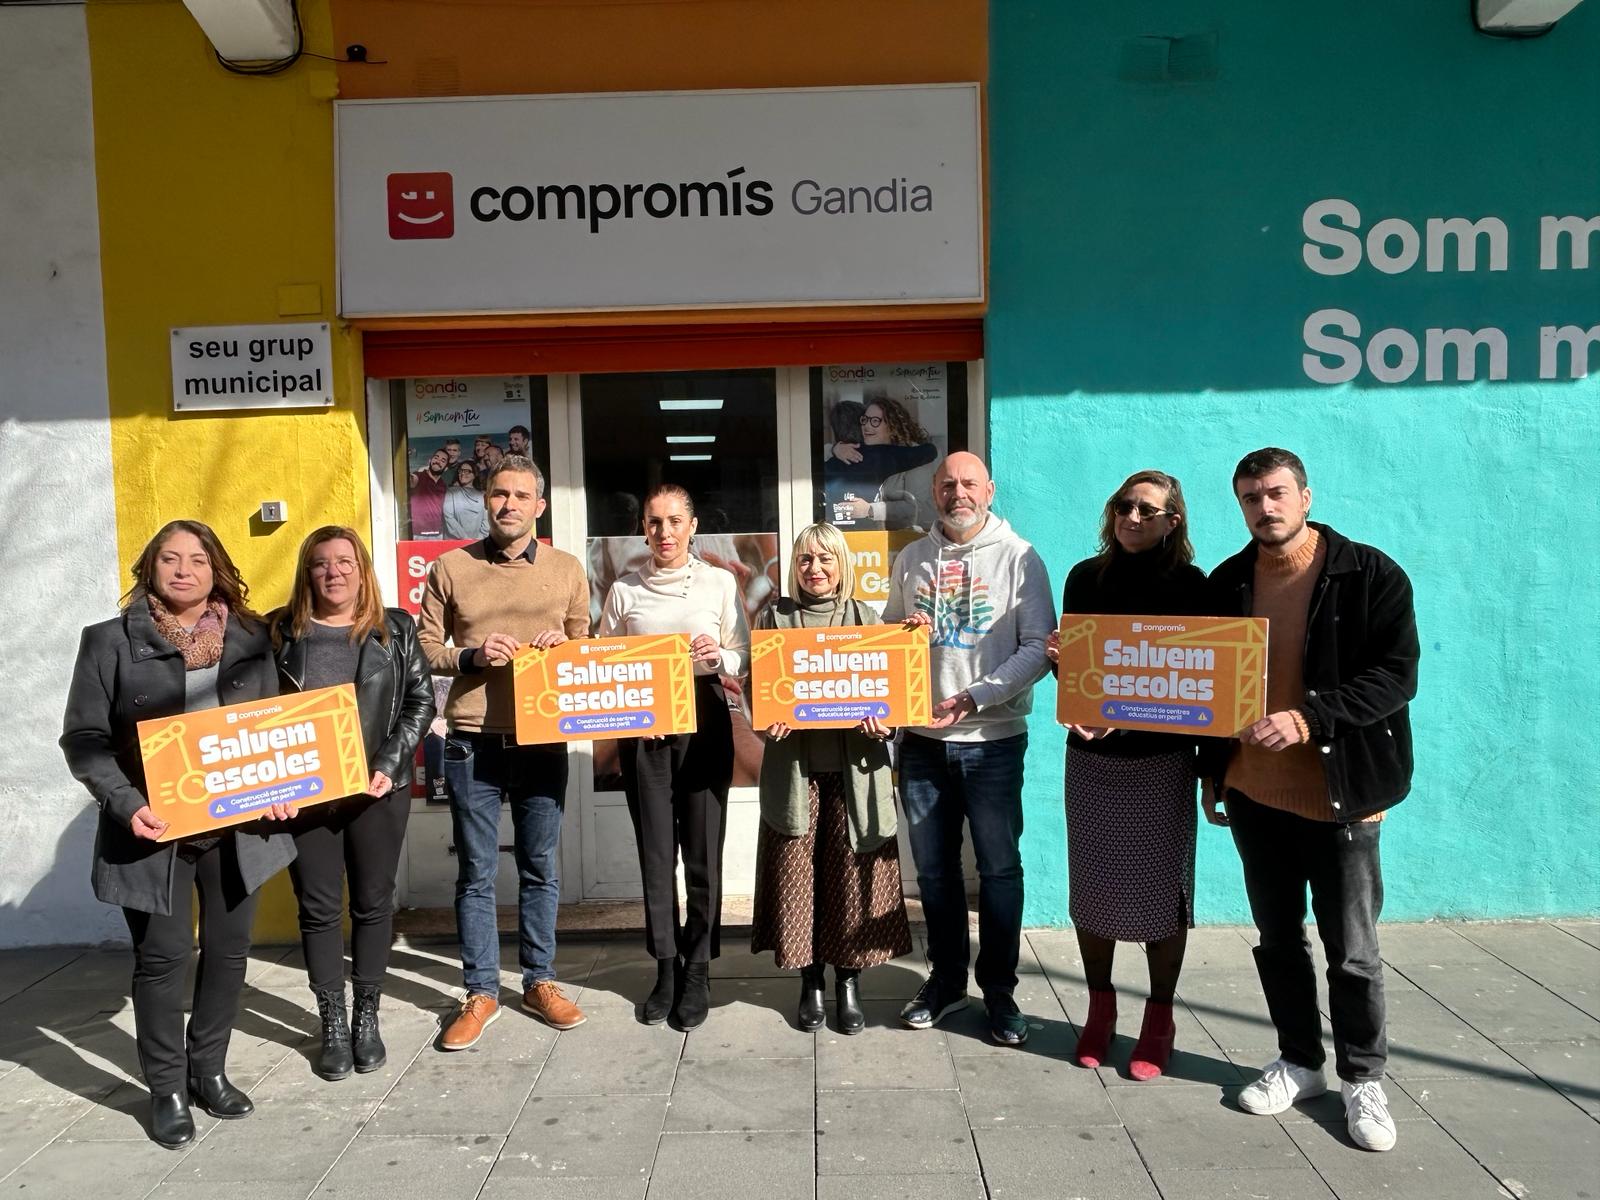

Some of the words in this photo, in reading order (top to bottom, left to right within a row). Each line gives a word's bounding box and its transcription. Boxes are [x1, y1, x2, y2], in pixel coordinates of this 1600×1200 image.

[469, 166, 774, 234] compromís
[790, 177, 934, 216] Gandia
[1302, 198, 1508, 276] Som
[189, 340, 239, 359] seu
[248, 337, 314, 363] grup
[1302, 308, 1508, 385] Som
[184, 368, 322, 398] municipal
[415, 379, 467, 399] gandia
[792, 649, 888, 674] Salvem
[1103, 639, 1215, 671] Salvem
[556, 660, 653, 686] Salvem
[793, 674, 890, 700] escoles
[1102, 671, 1214, 701] escoles
[558, 684, 655, 712] escoles
[1120, 704, 1157, 713] Construcció
[199, 721, 317, 765] Salvem
[204, 749, 321, 794] escoles
